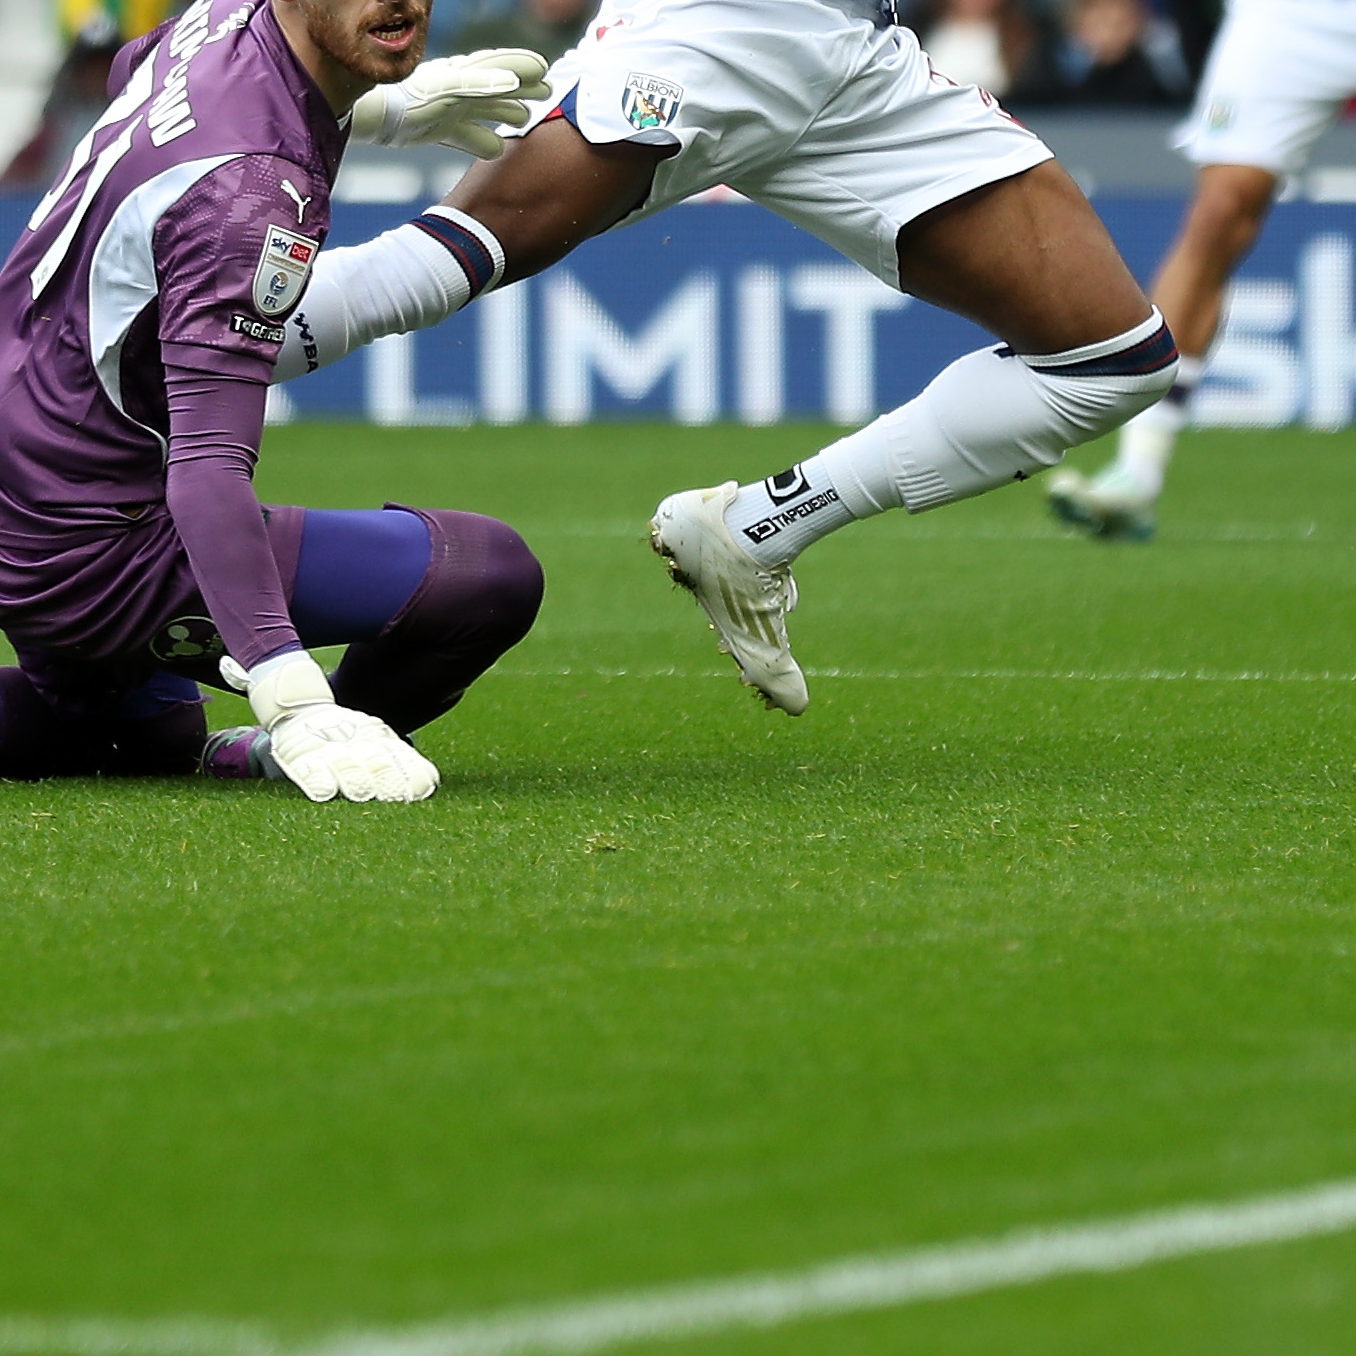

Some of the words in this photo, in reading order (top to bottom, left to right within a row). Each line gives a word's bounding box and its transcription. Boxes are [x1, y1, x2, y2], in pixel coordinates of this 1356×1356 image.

[628, 78, 680, 99] ALBION
[271, 237, 291, 254] sky
[263, 294, 280, 309] EFL
[233, 314, 285, 342] TOGETHER
[294, 312, 320, 375] WBA
